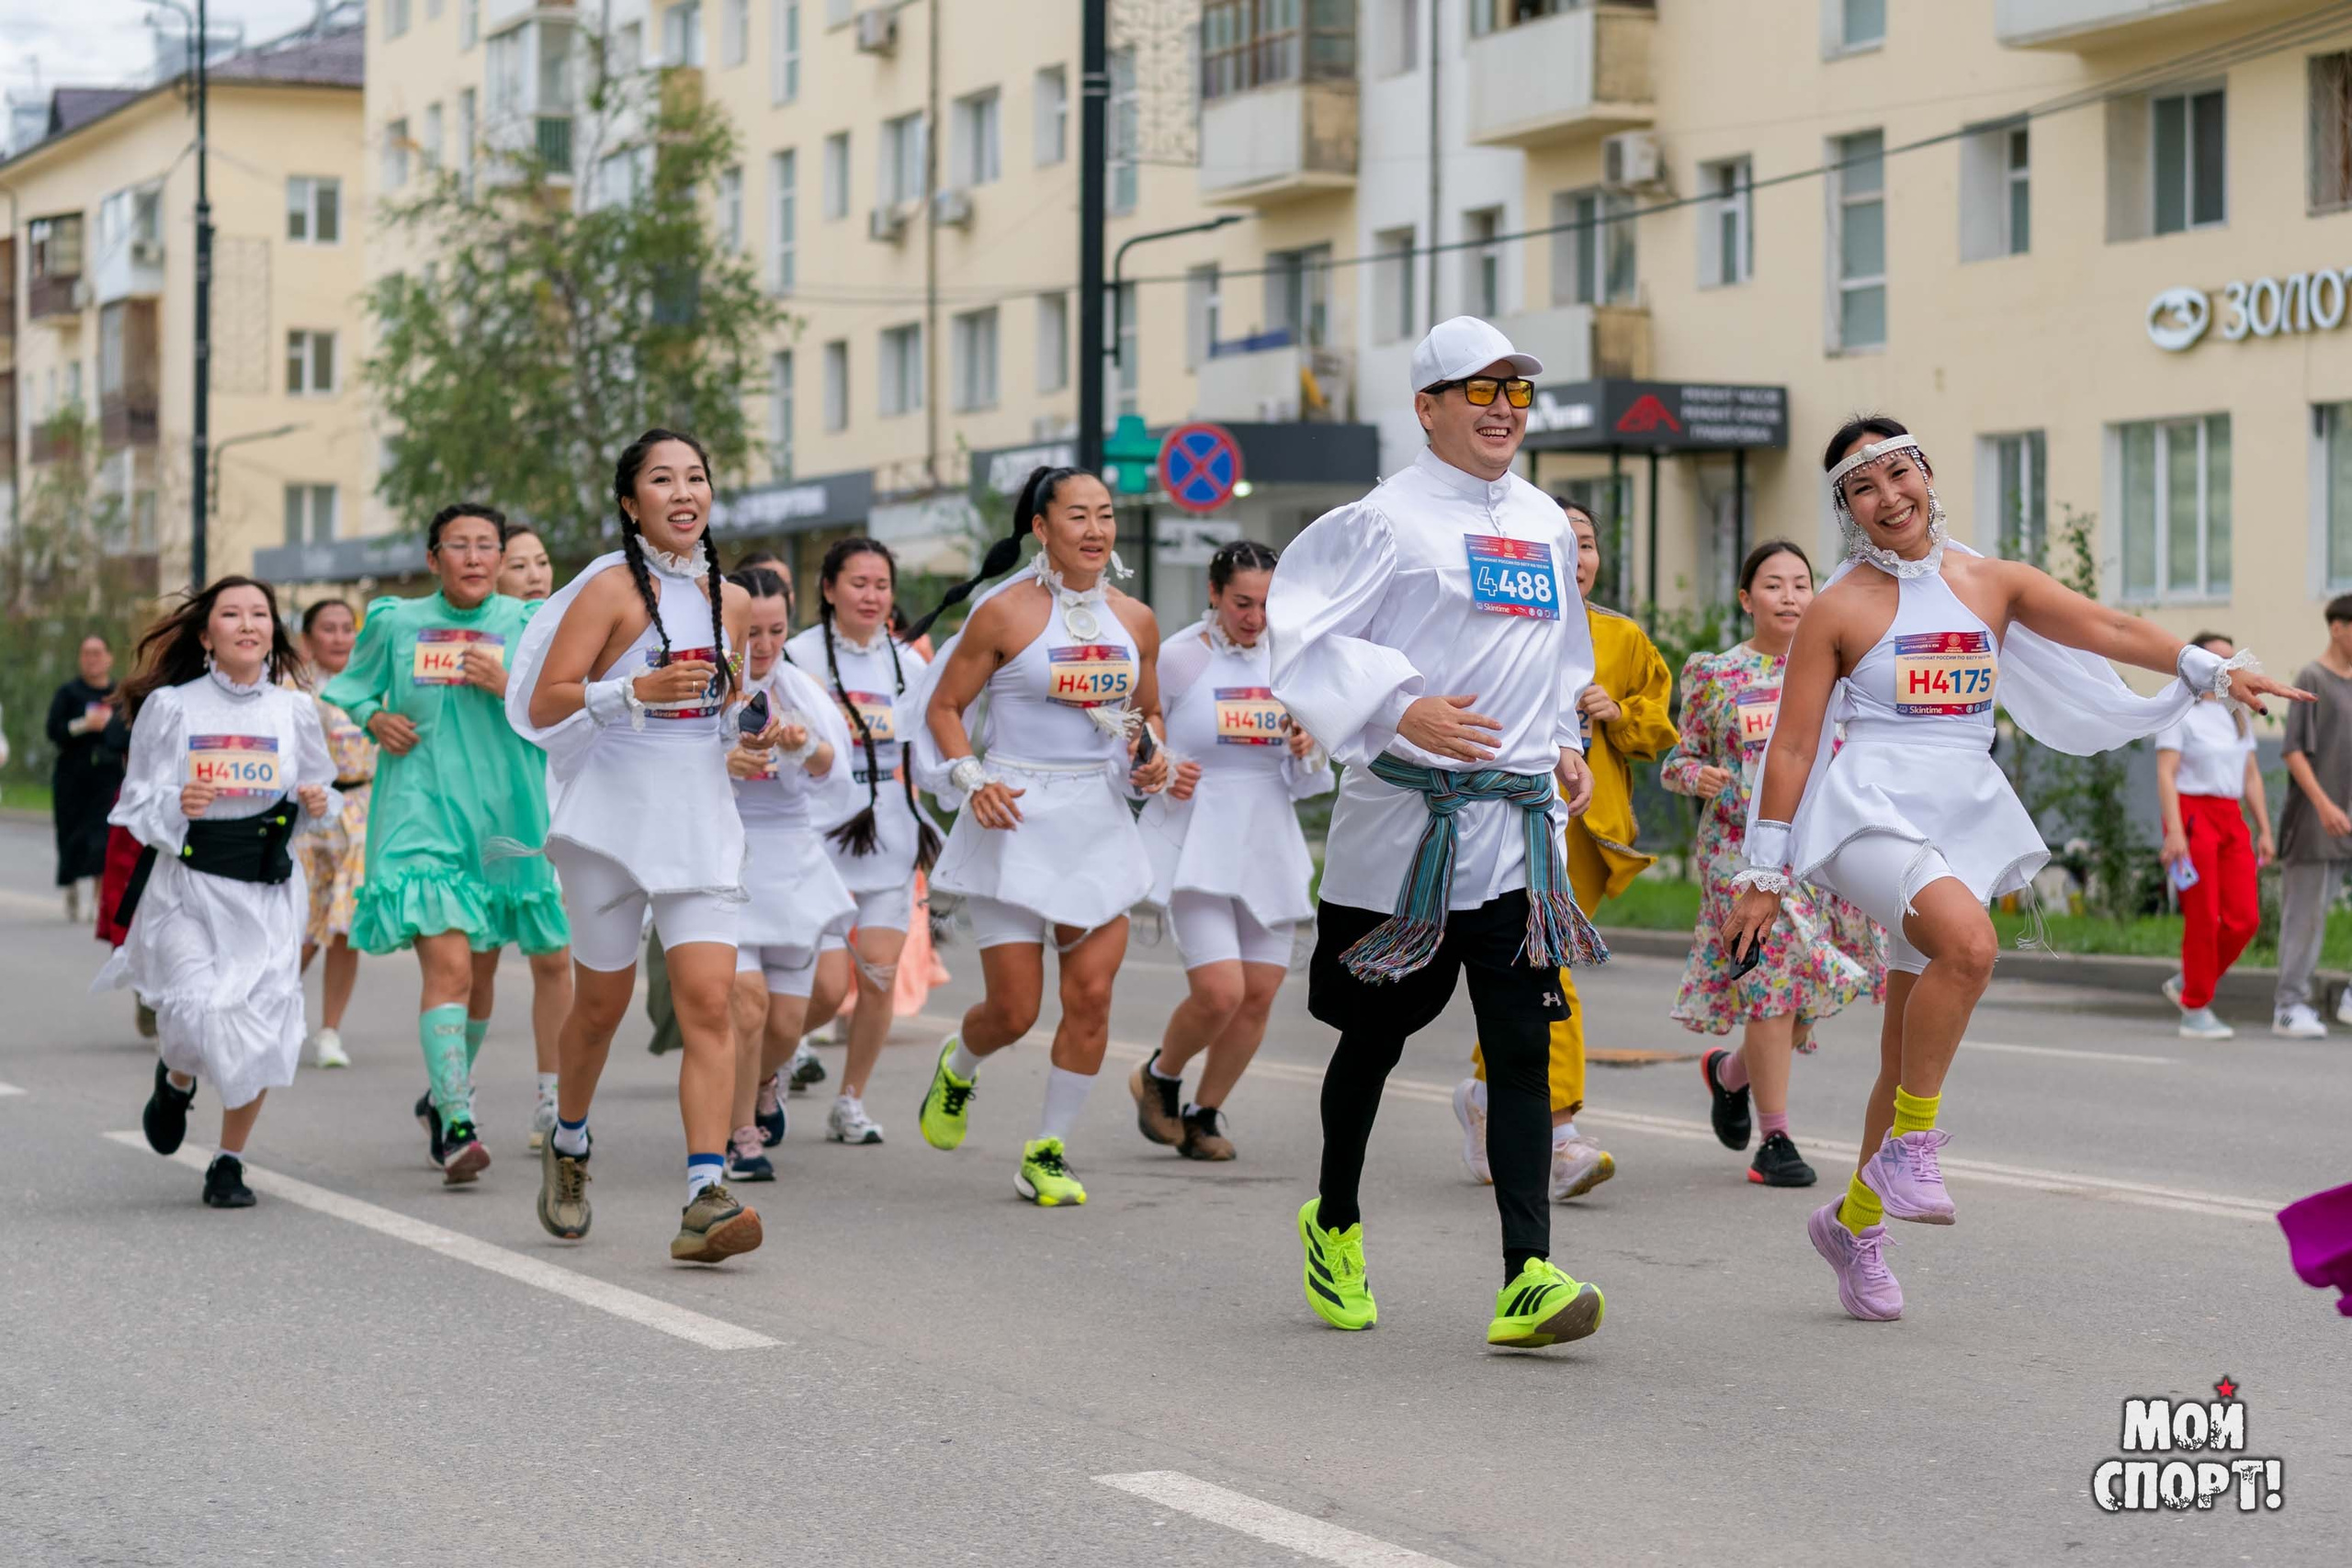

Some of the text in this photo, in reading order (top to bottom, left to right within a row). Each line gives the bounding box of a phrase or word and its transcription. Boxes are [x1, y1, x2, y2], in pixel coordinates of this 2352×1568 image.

[1477, 567, 1552, 603] 4488
[1484, 603, 1510, 614] Skintime
[1058, 673, 1127, 693] H4195
[1909, 668, 1992, 694] H4175
[1909, 705, 1943, 714] Skintime
[196, 761, 274, 783] H4160
